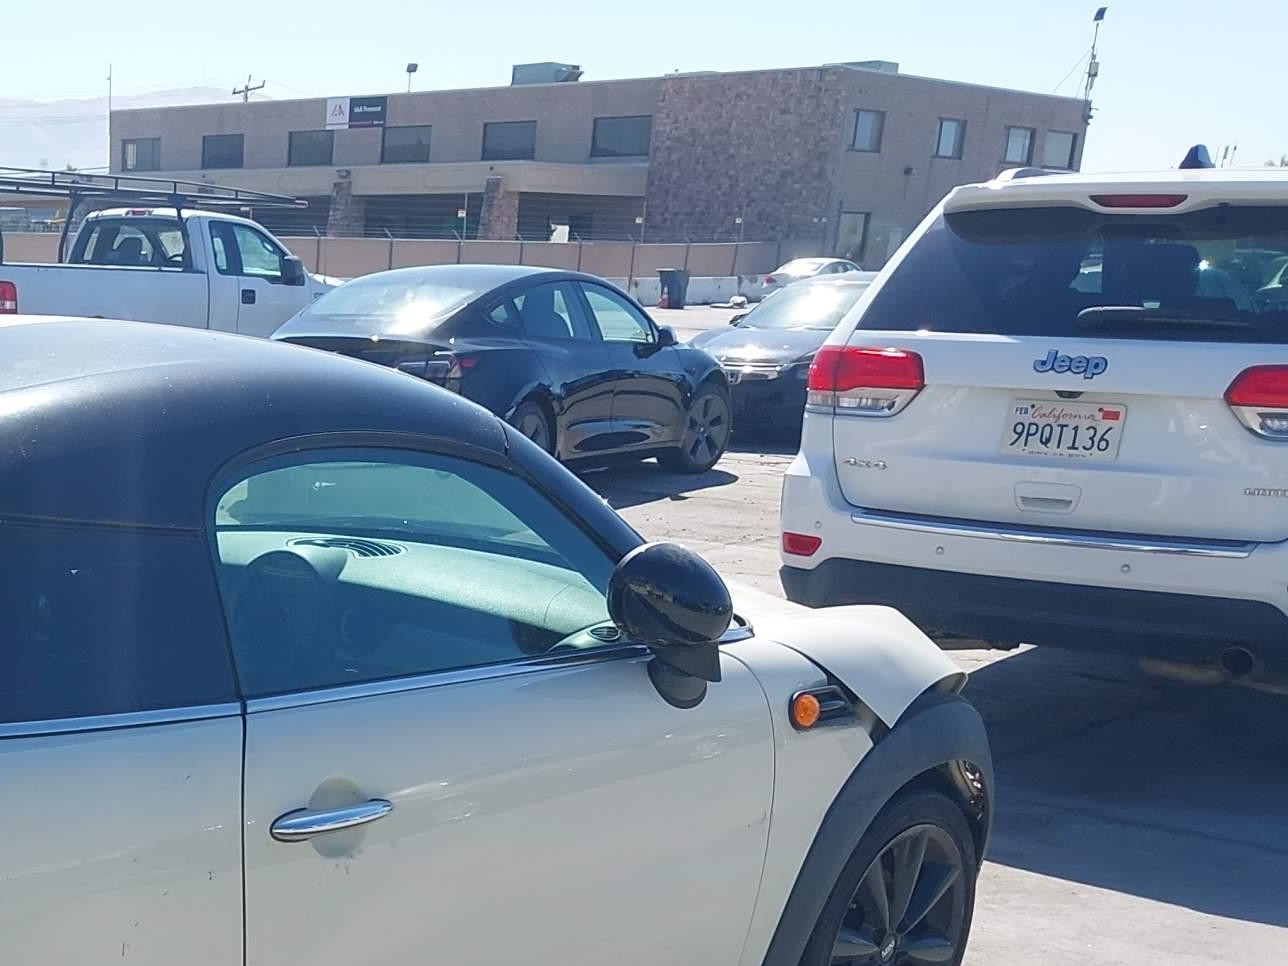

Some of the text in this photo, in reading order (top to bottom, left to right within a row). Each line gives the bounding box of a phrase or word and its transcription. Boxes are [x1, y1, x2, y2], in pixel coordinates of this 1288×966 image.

[1033, 349, 1108, 379] Jeep
[1032, 406, 1099, 423] California
[1009, 421, 1114, 452] 9PQT136
